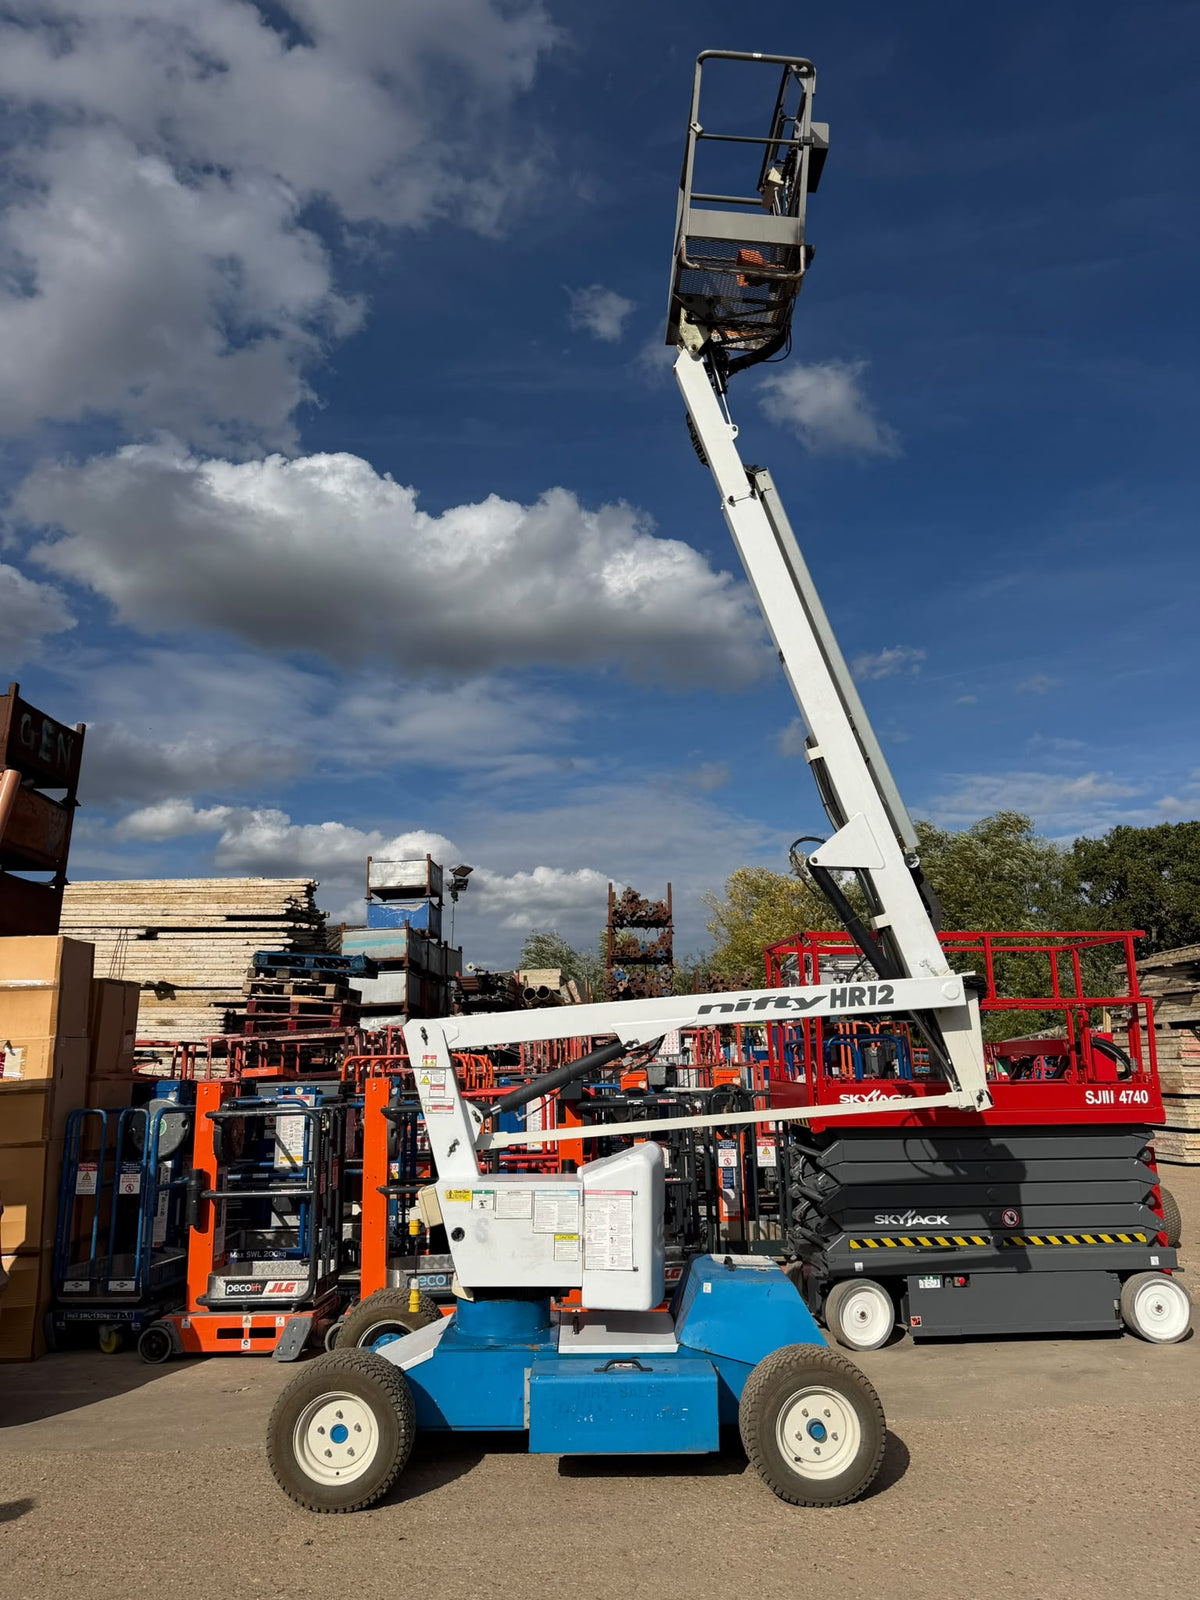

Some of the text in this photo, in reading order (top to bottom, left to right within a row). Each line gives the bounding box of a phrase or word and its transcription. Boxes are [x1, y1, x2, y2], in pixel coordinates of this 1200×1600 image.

[20, 712, 74, 771] GEN
[698, 984, 894, 1015] nifty HR12
[1119, 1090, 1149, 1104] 4740
[874, 1210, 950, 1227] SKYJACK
[246, 1250, 262, 1258] SWL
[263, 1250, 287, 1259] 200kg
[664, 1268, 683, 1279] LG
[226, 1282, 297, 1295] pecolift JLG
